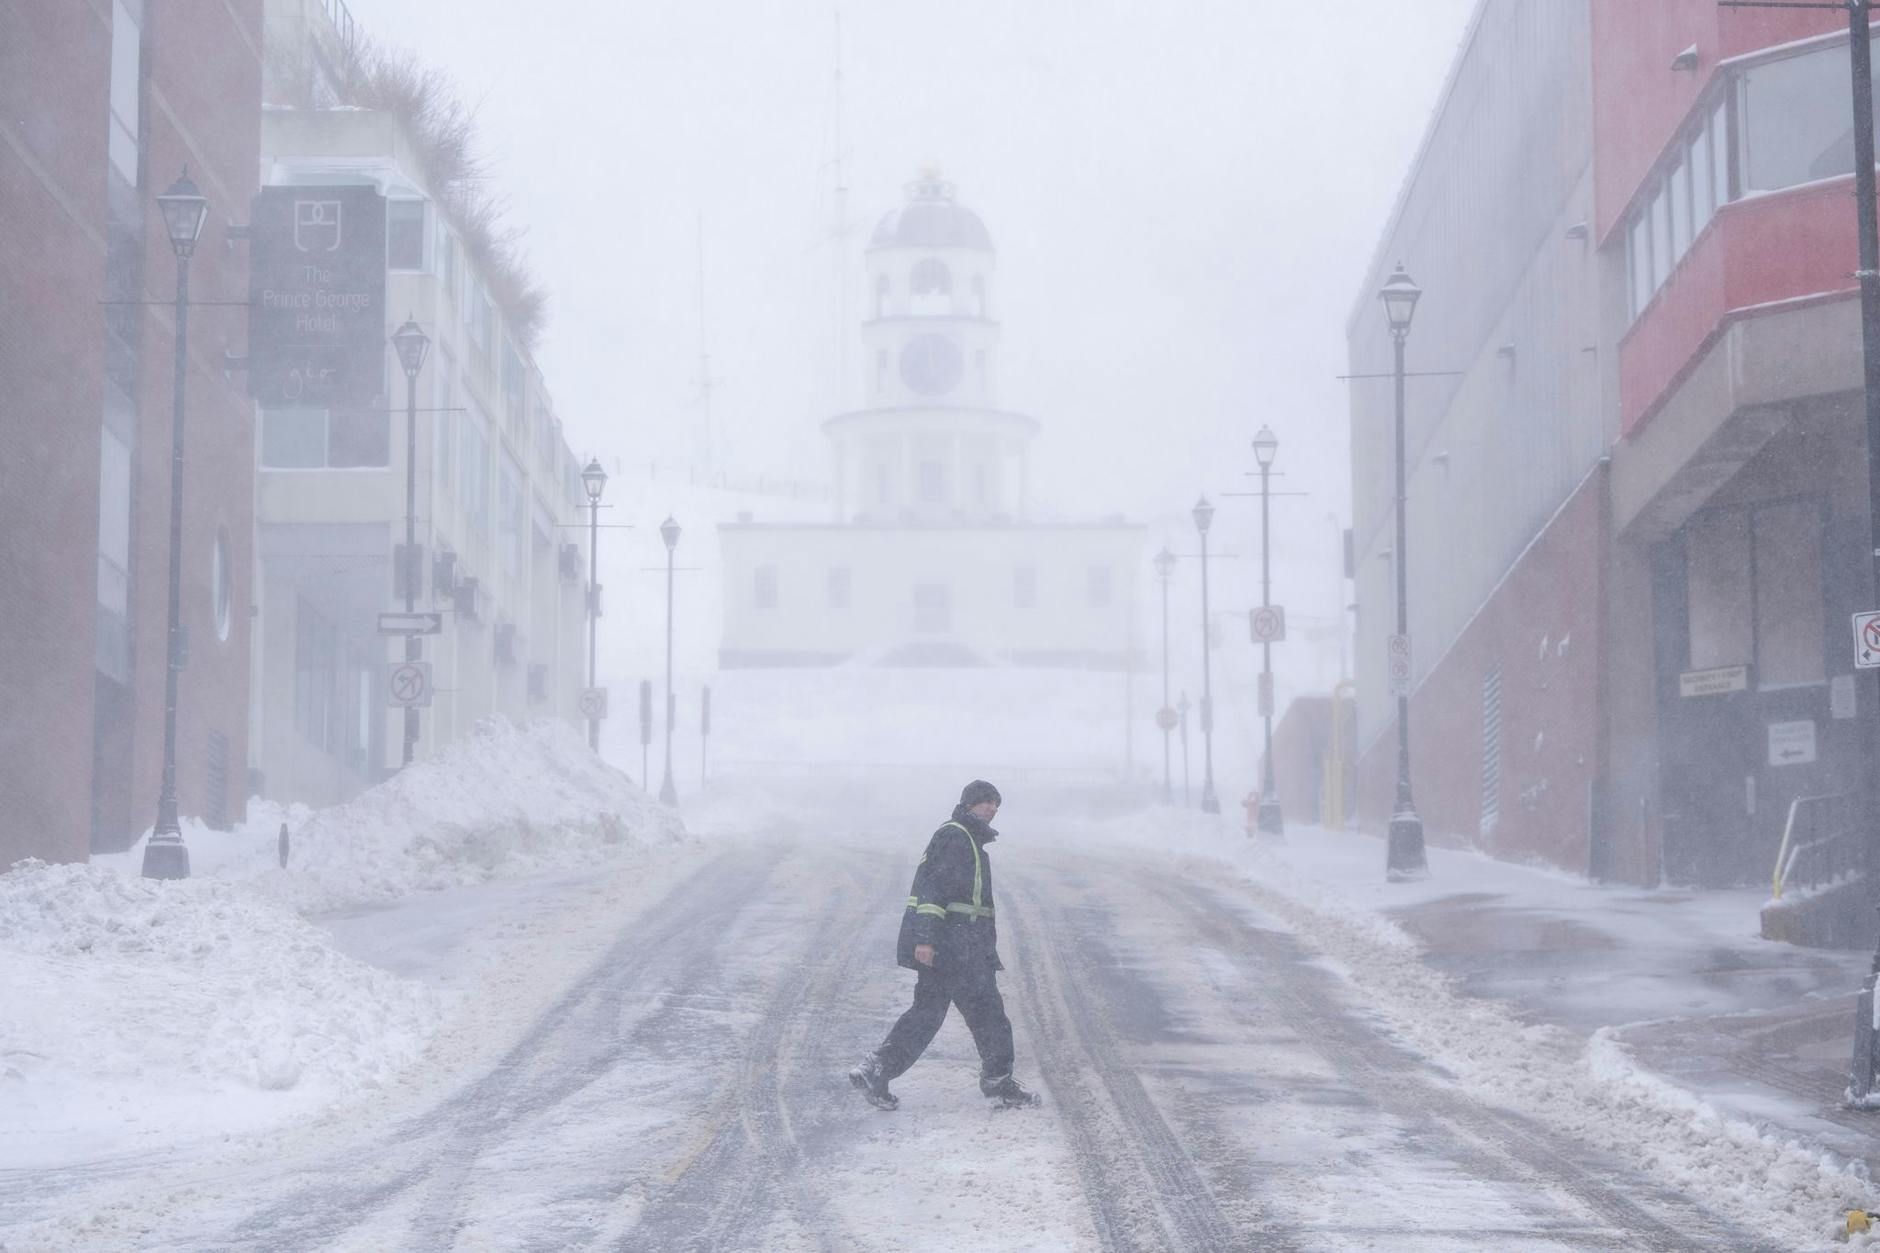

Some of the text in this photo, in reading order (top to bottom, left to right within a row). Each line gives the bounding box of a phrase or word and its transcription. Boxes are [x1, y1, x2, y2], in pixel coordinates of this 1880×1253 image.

[303, 265, 331, 283] The
[263, 289, 370, 313] Prince George
[296, 313, 336, 334] Hotel
